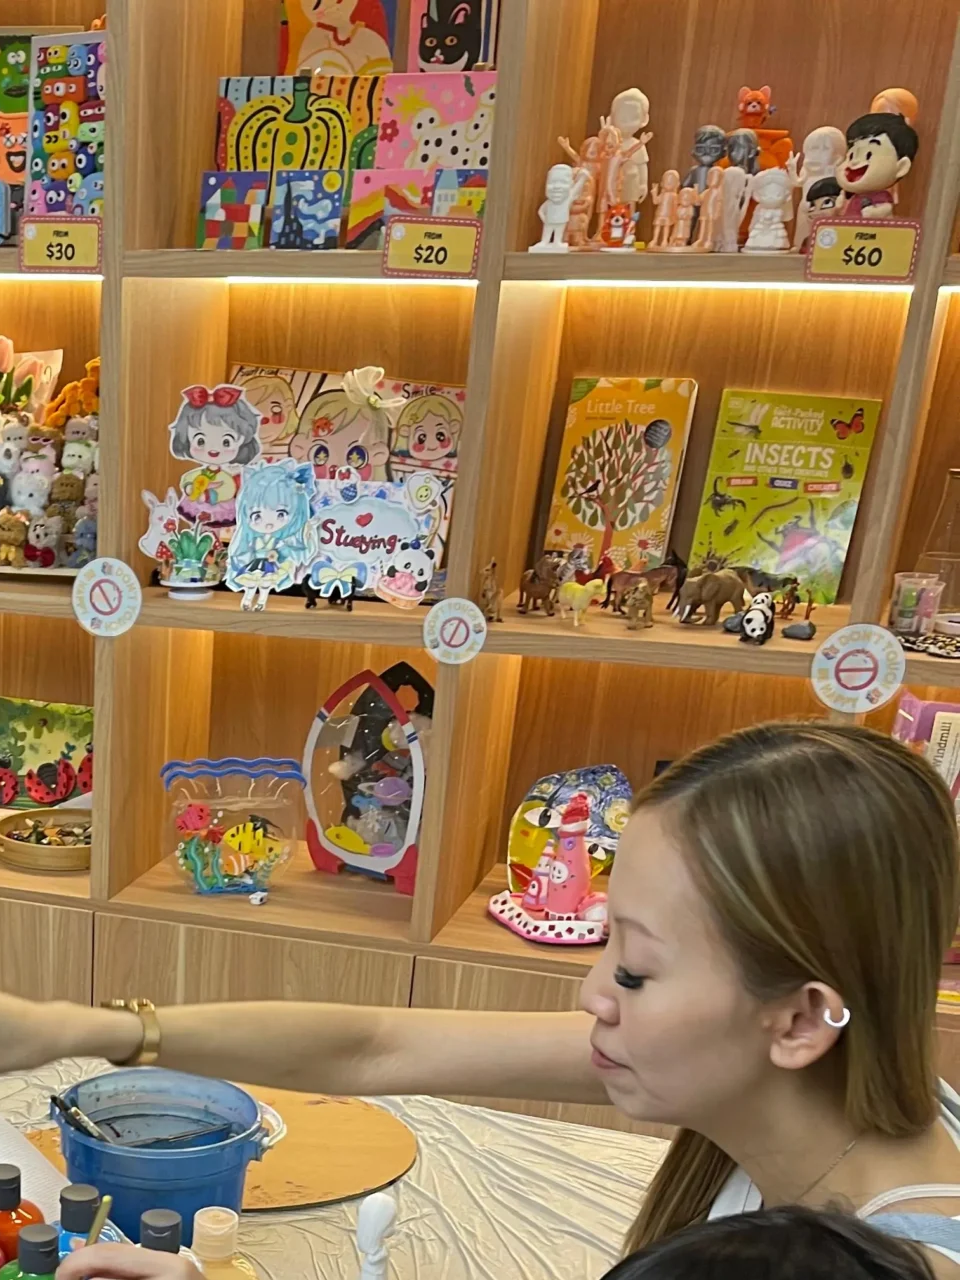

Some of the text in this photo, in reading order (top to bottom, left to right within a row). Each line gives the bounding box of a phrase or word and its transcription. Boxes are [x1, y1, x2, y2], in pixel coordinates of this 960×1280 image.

[52, 229, 69, 238] FROM
[423, 231, 443, 240] FROM
[854, 232, 877, 241] FROM
[46, 242, 76, 261] $30
[413, 244, 448, 266] $20
[842, 245, 883, 267] $60
[586, 400, 657, 415] Little Tree
[771, 416, 825, 433] ACTIVITY
[744, 442, 836, 469] INSECTS
